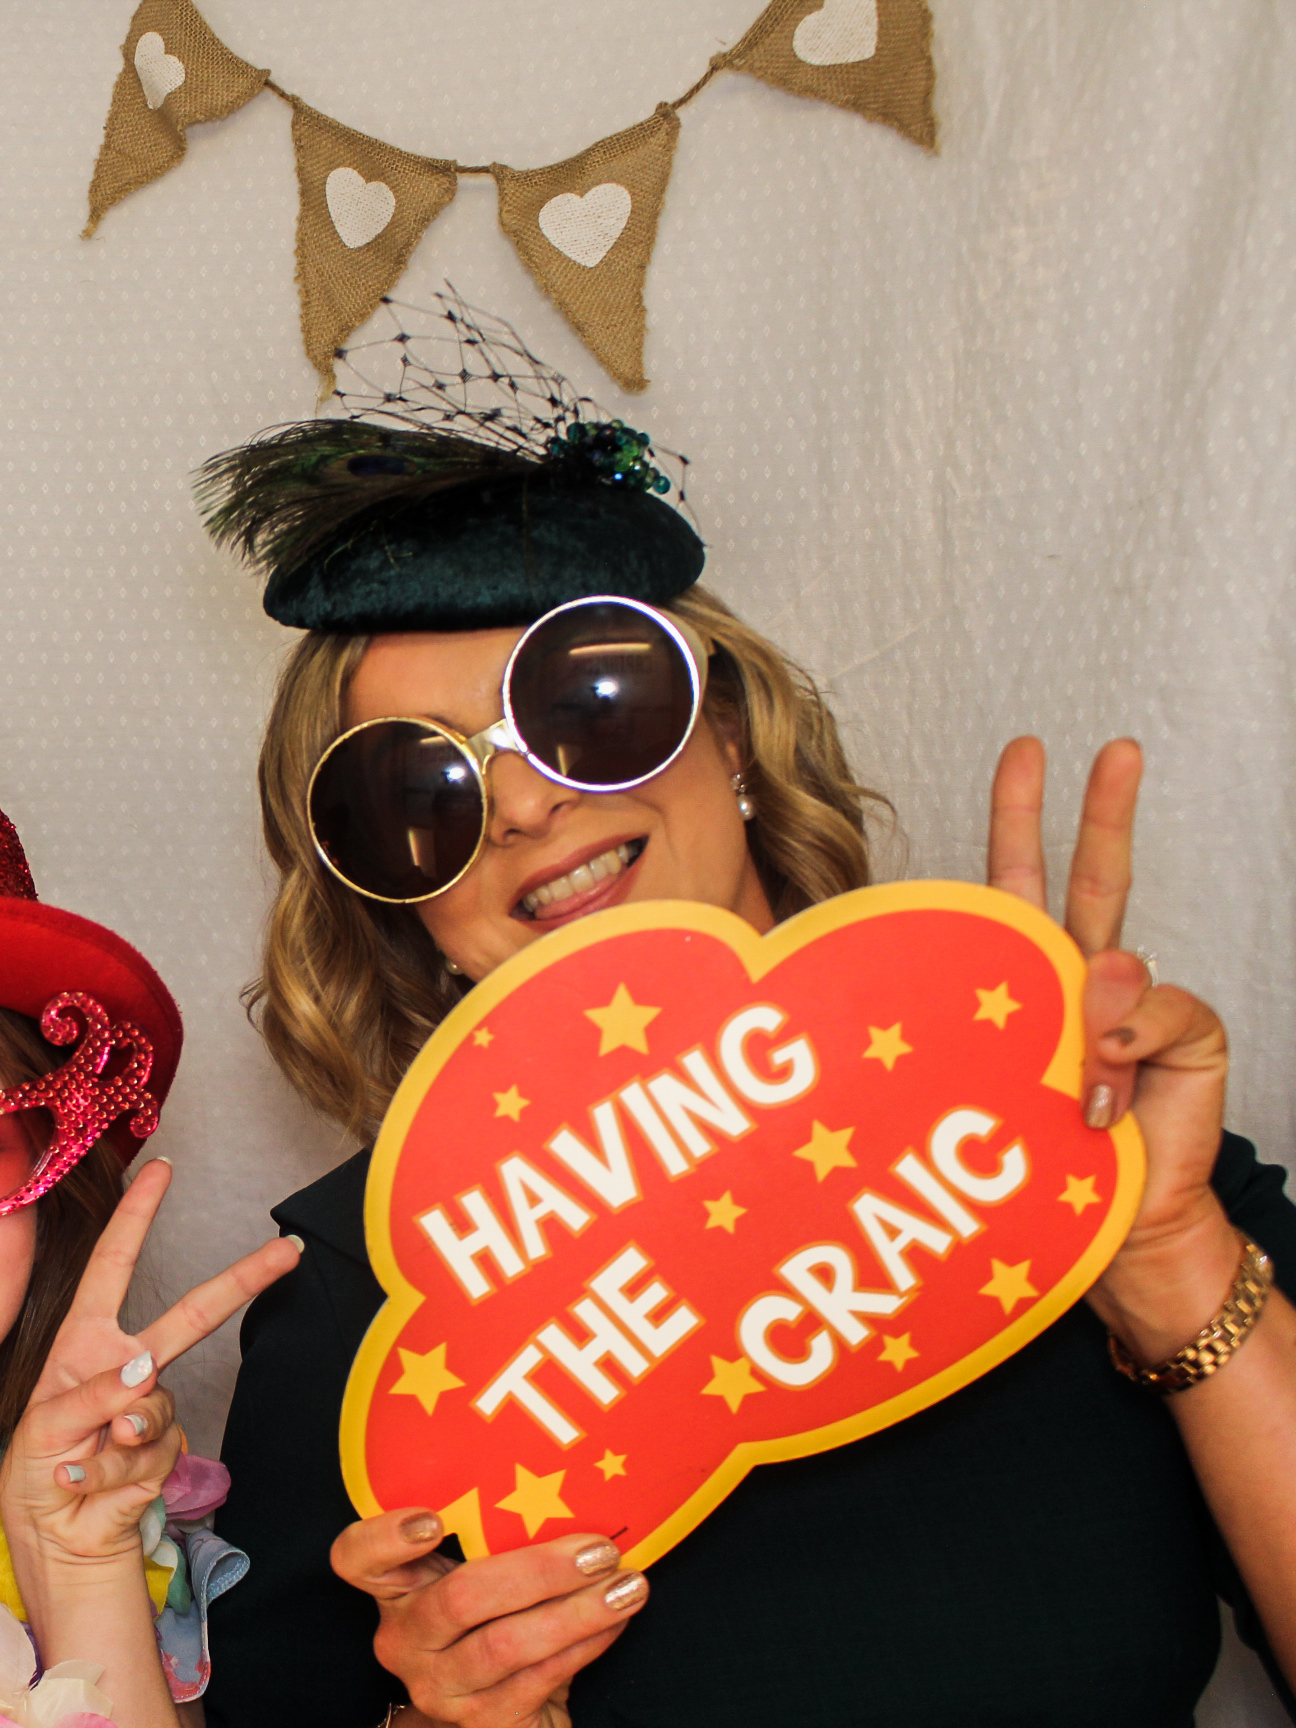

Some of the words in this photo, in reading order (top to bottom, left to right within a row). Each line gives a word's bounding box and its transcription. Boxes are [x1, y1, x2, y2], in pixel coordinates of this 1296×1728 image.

[419, 1005, 816, 1300] HAVING
[738, 1109, 1027, 1387] CRAIC
[475, 1246, 700, 1446] THE
